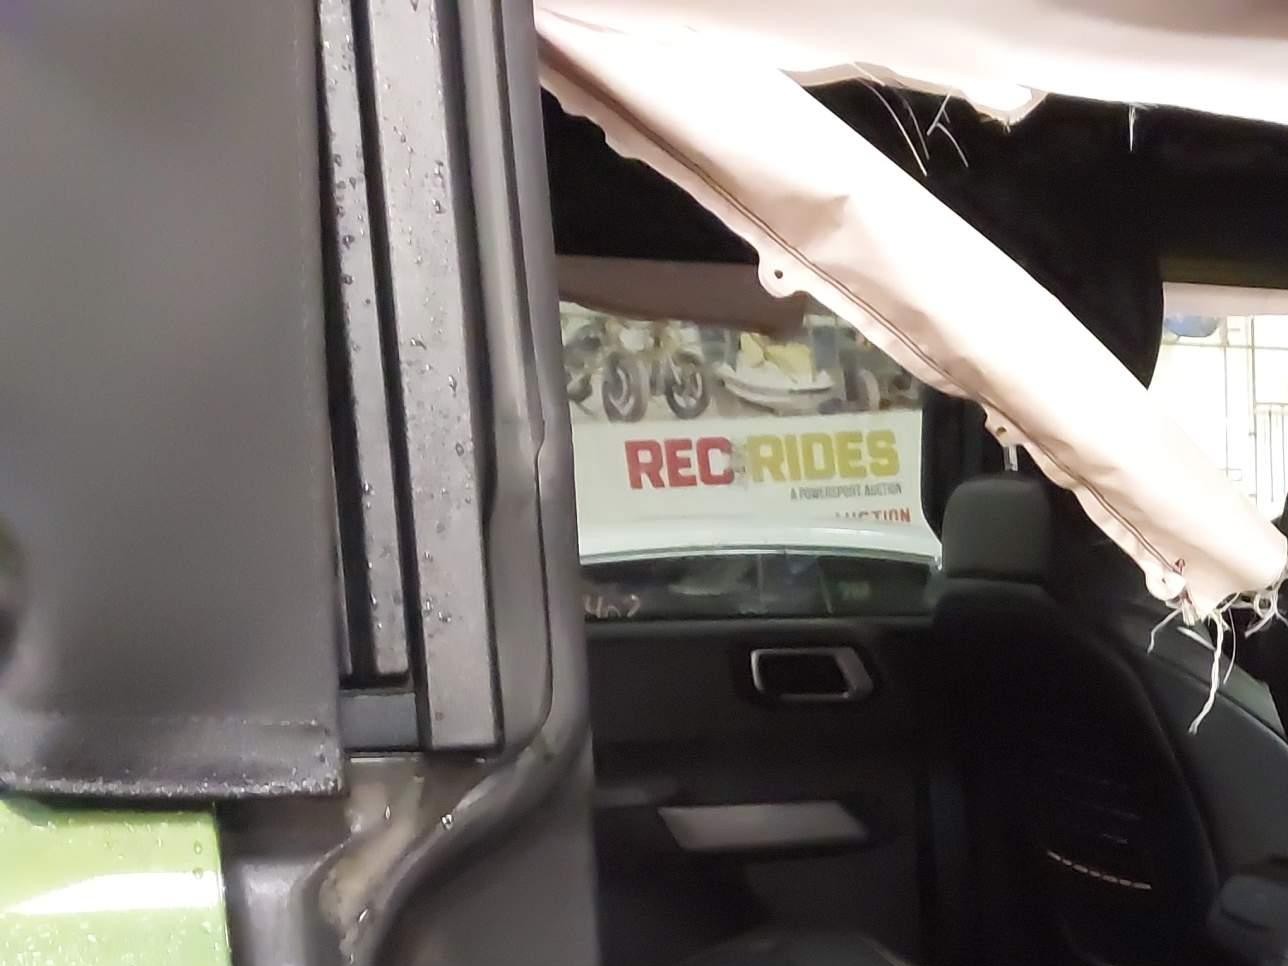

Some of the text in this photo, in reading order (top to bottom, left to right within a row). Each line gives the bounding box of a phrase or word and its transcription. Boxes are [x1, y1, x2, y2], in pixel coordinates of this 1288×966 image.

[624, 430, 901, 490] REC RIDES
[834, 507, 911, 523] TION
